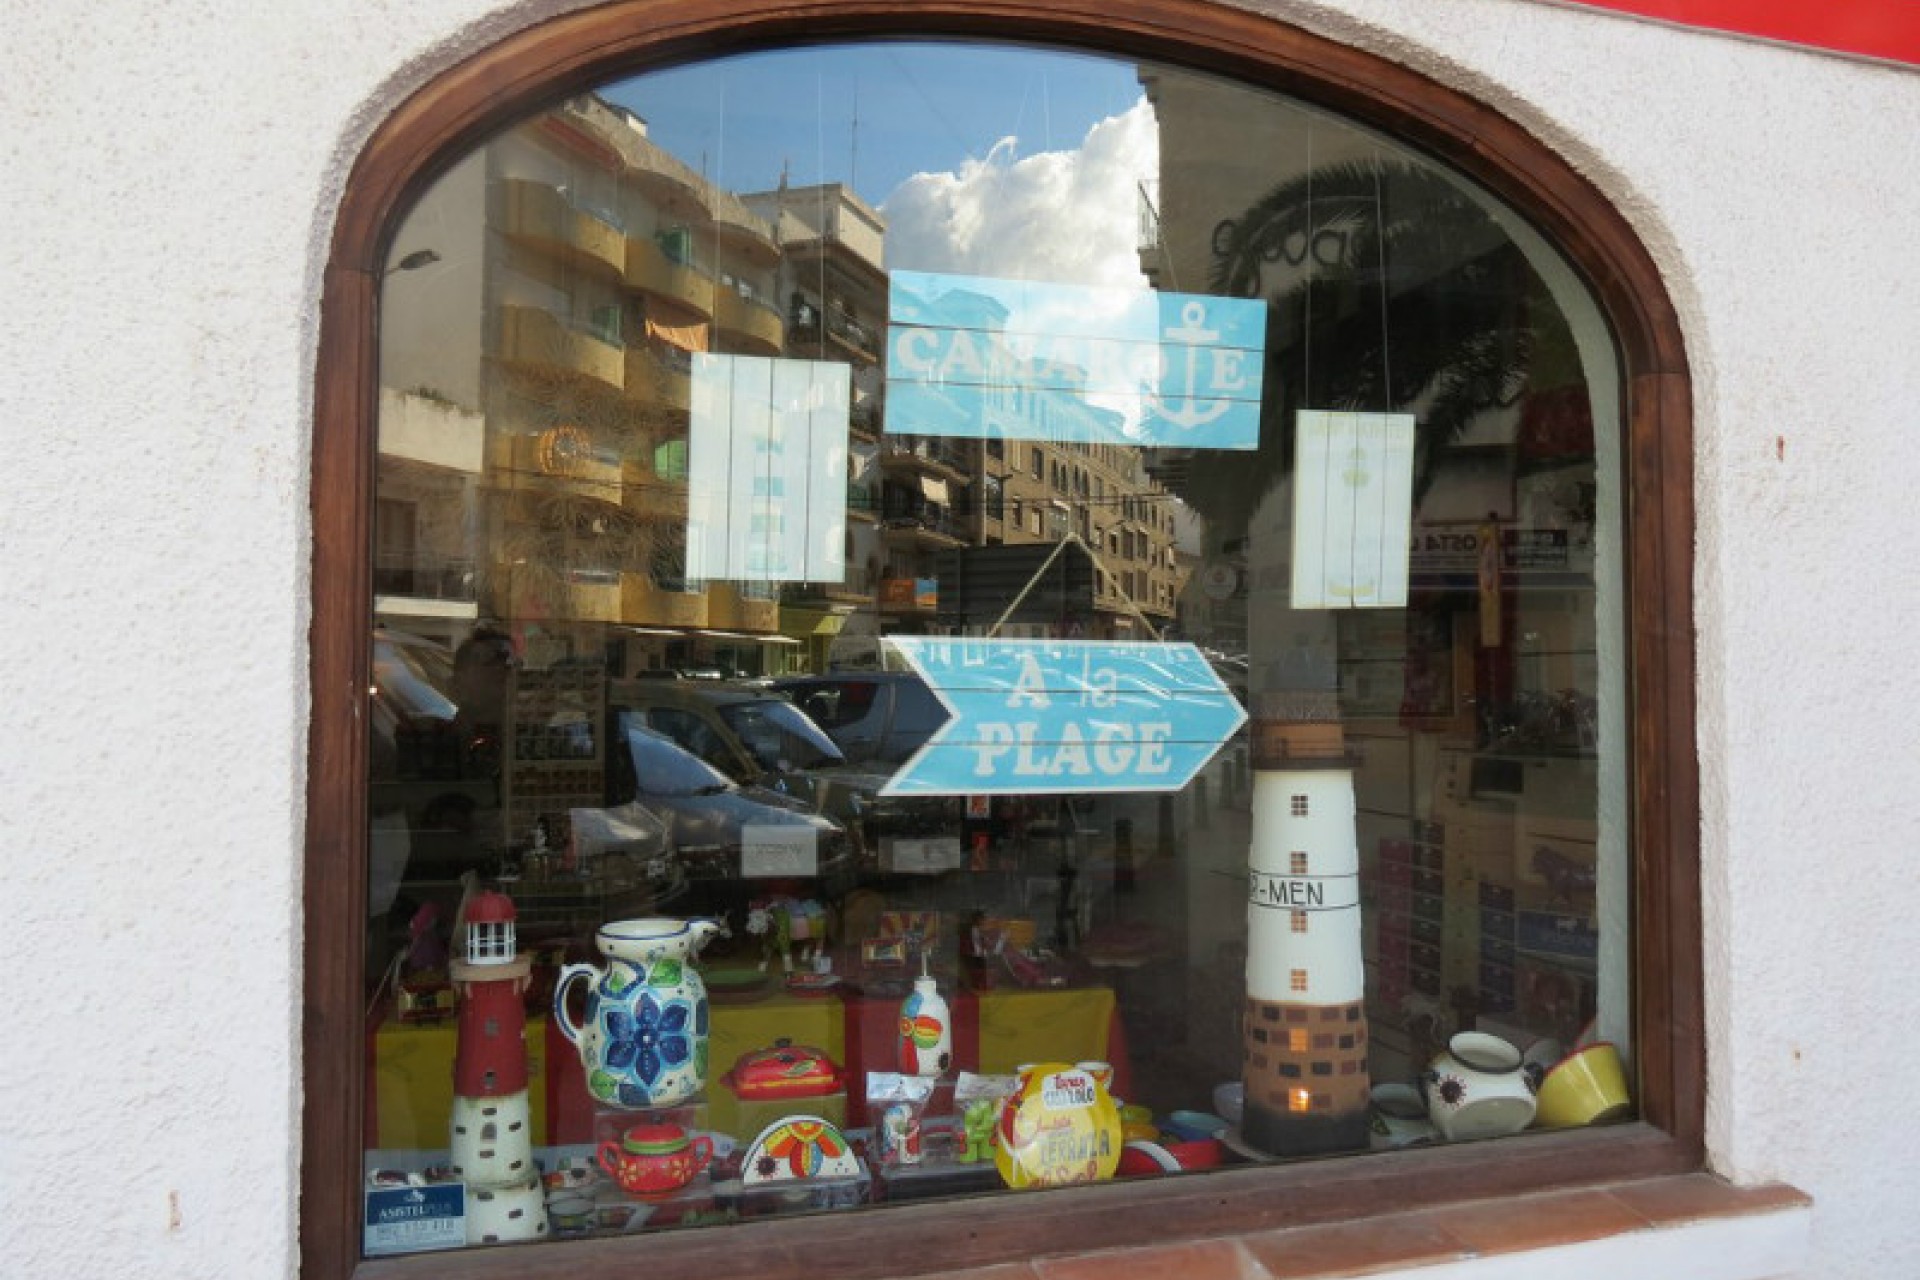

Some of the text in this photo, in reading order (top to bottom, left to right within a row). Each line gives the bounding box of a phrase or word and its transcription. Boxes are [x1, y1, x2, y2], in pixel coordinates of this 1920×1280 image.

[1006, 648, 1118, 709] A la
[974, 720, 1172, 776] PLAGE
